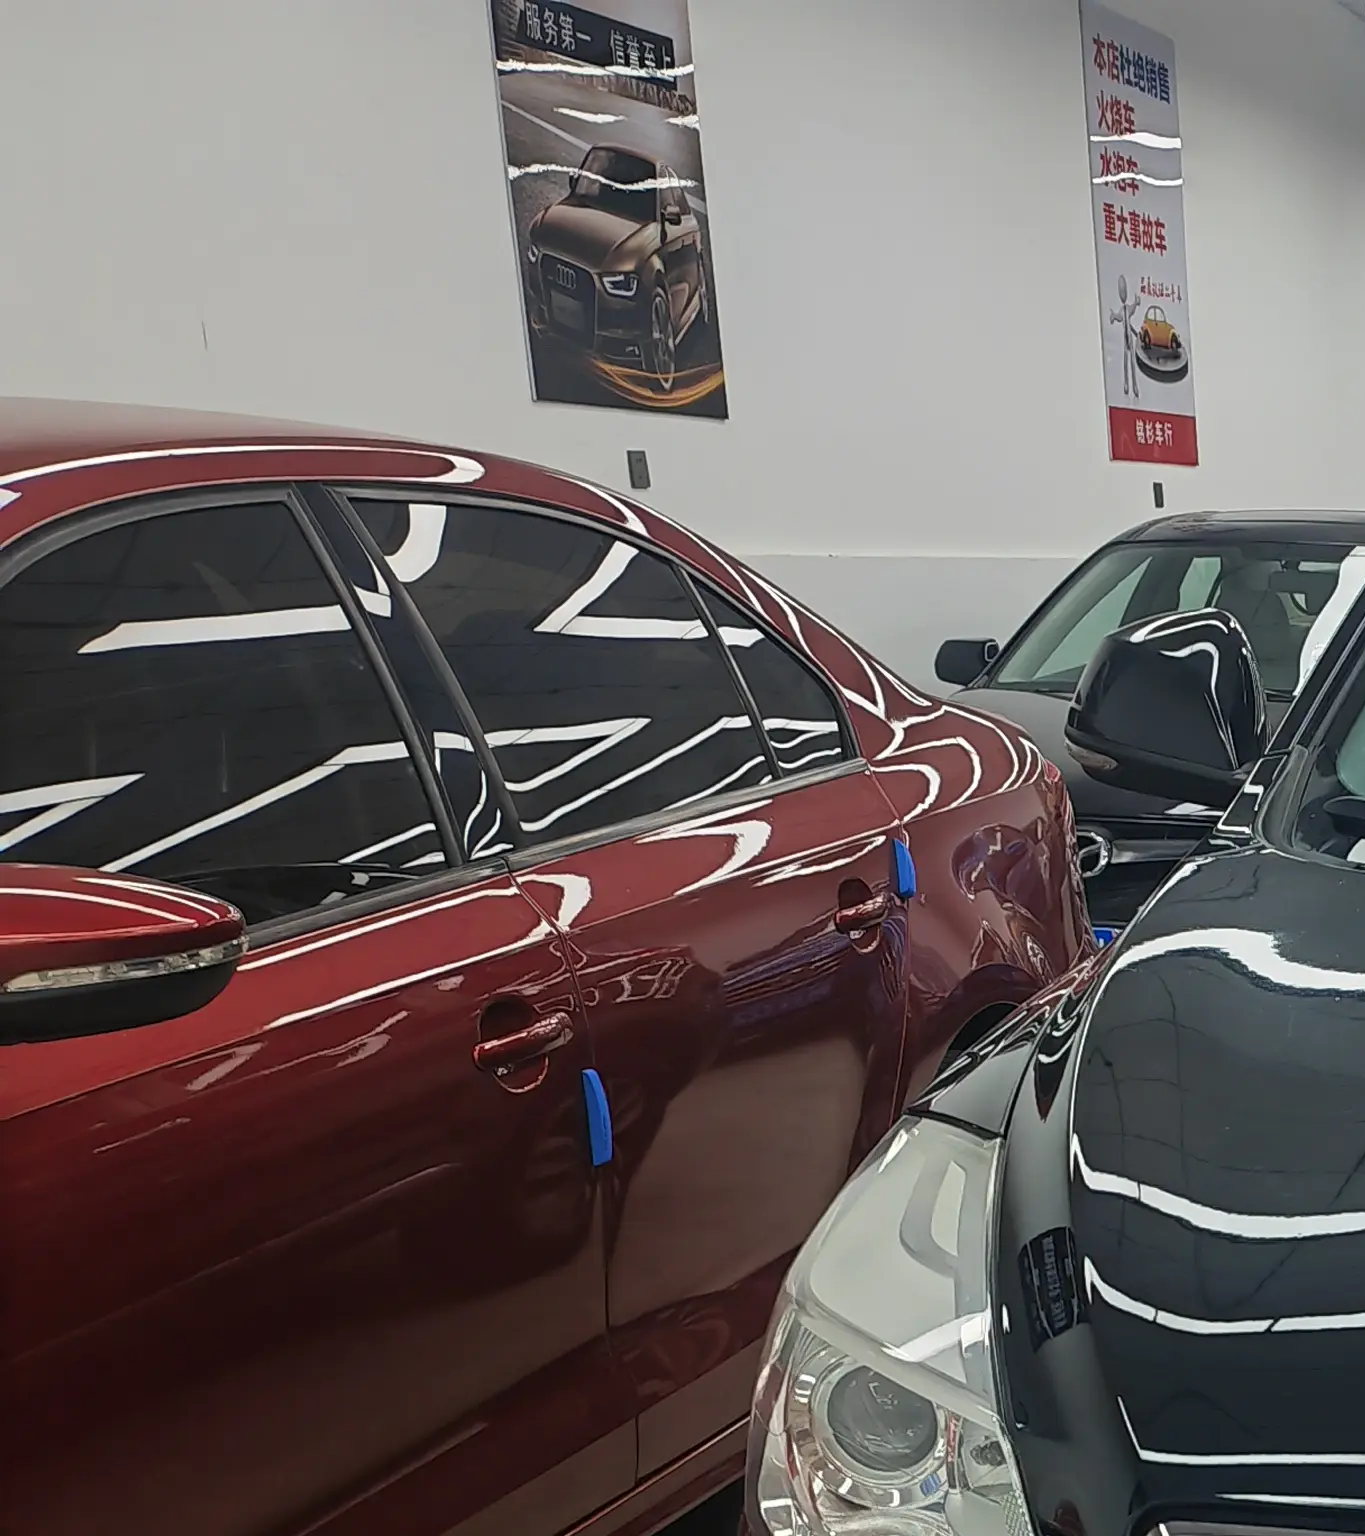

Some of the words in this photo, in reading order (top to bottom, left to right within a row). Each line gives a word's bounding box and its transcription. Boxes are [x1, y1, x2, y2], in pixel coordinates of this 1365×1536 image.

[524, 1, 592, 52] 服务第一
[609, 29, 675, 83] 信誉至上
[1092, 32, 1170, 105] 本店杜绝销售
[1096, 89, 1136, 137] 火烧车
[1100, 145, 1140, 197] 水泡车
[1103, 201, 1168, 257] 重大事故车
